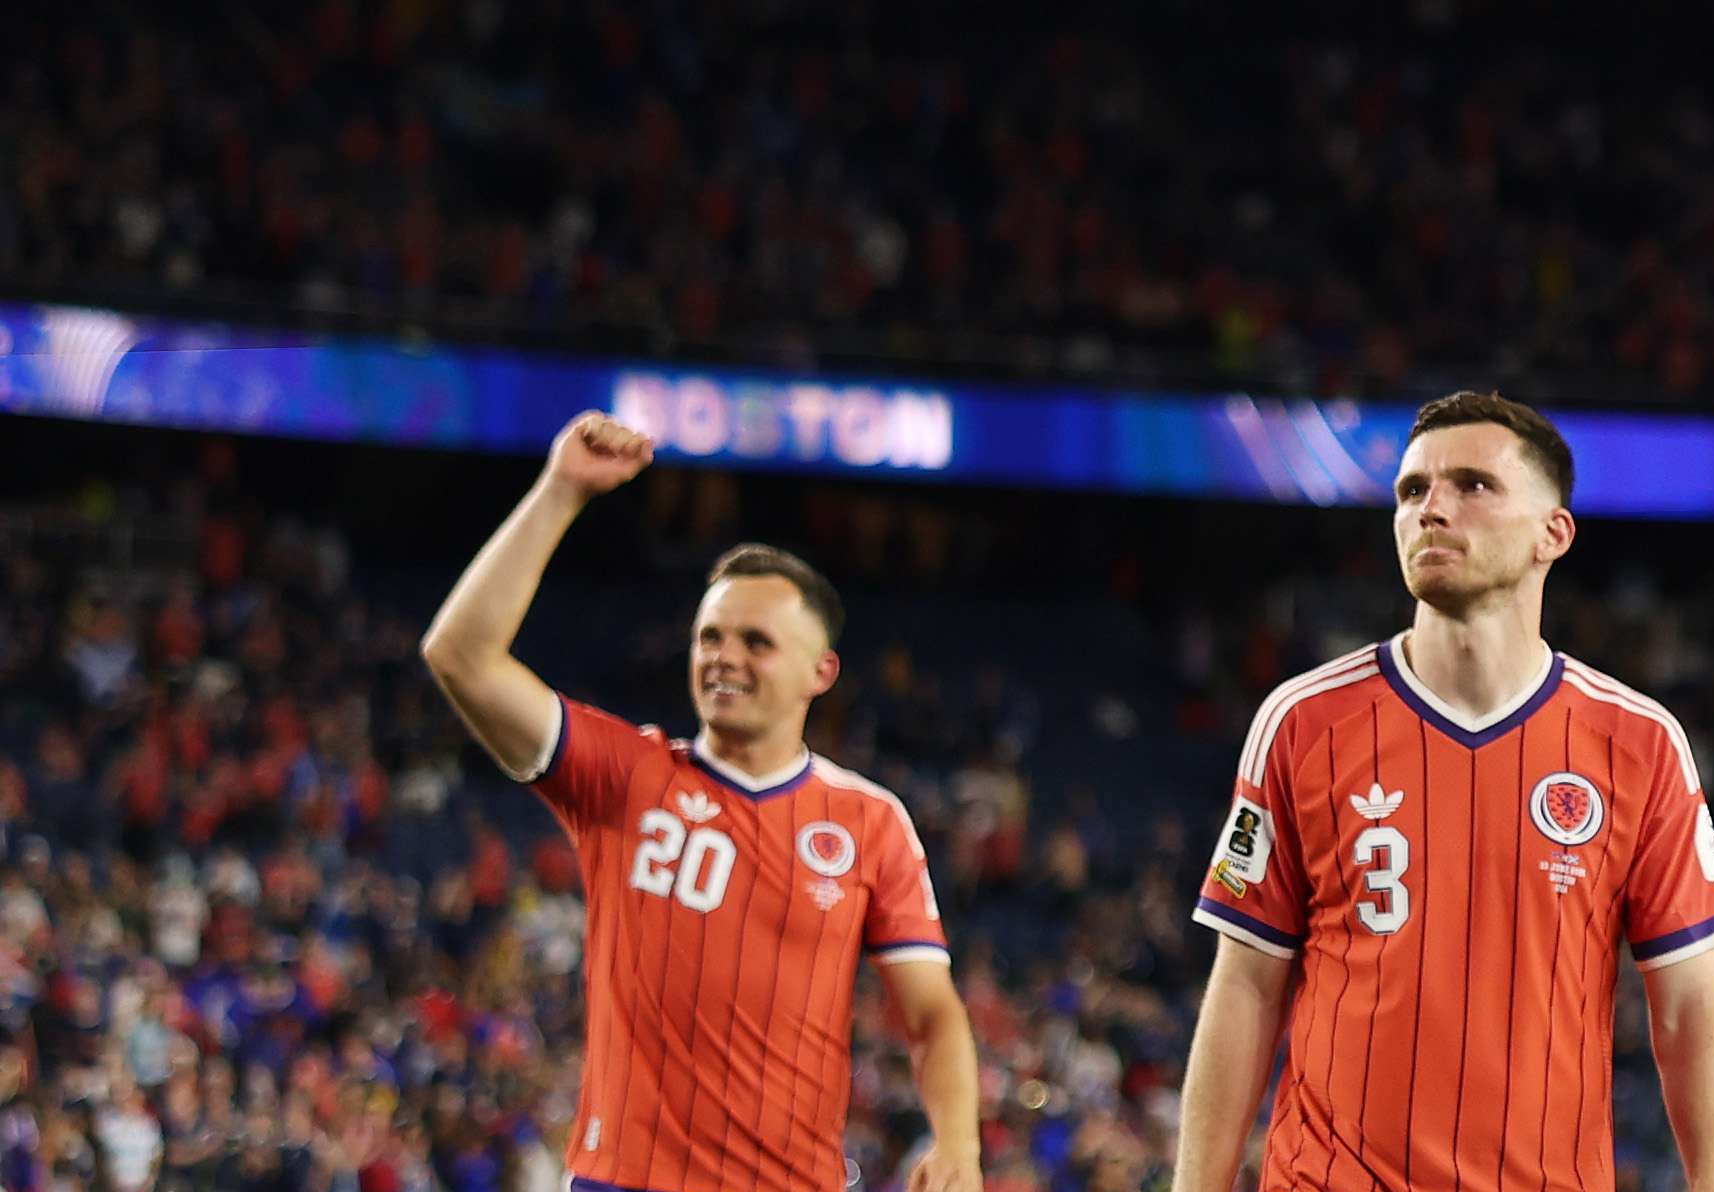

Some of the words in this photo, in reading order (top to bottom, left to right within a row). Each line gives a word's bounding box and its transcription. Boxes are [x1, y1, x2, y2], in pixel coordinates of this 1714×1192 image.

[614, 374, 953, 469] BOSTON
[630, 807, 738, 914] 20
[1355, 826, 1410, 936] 3
